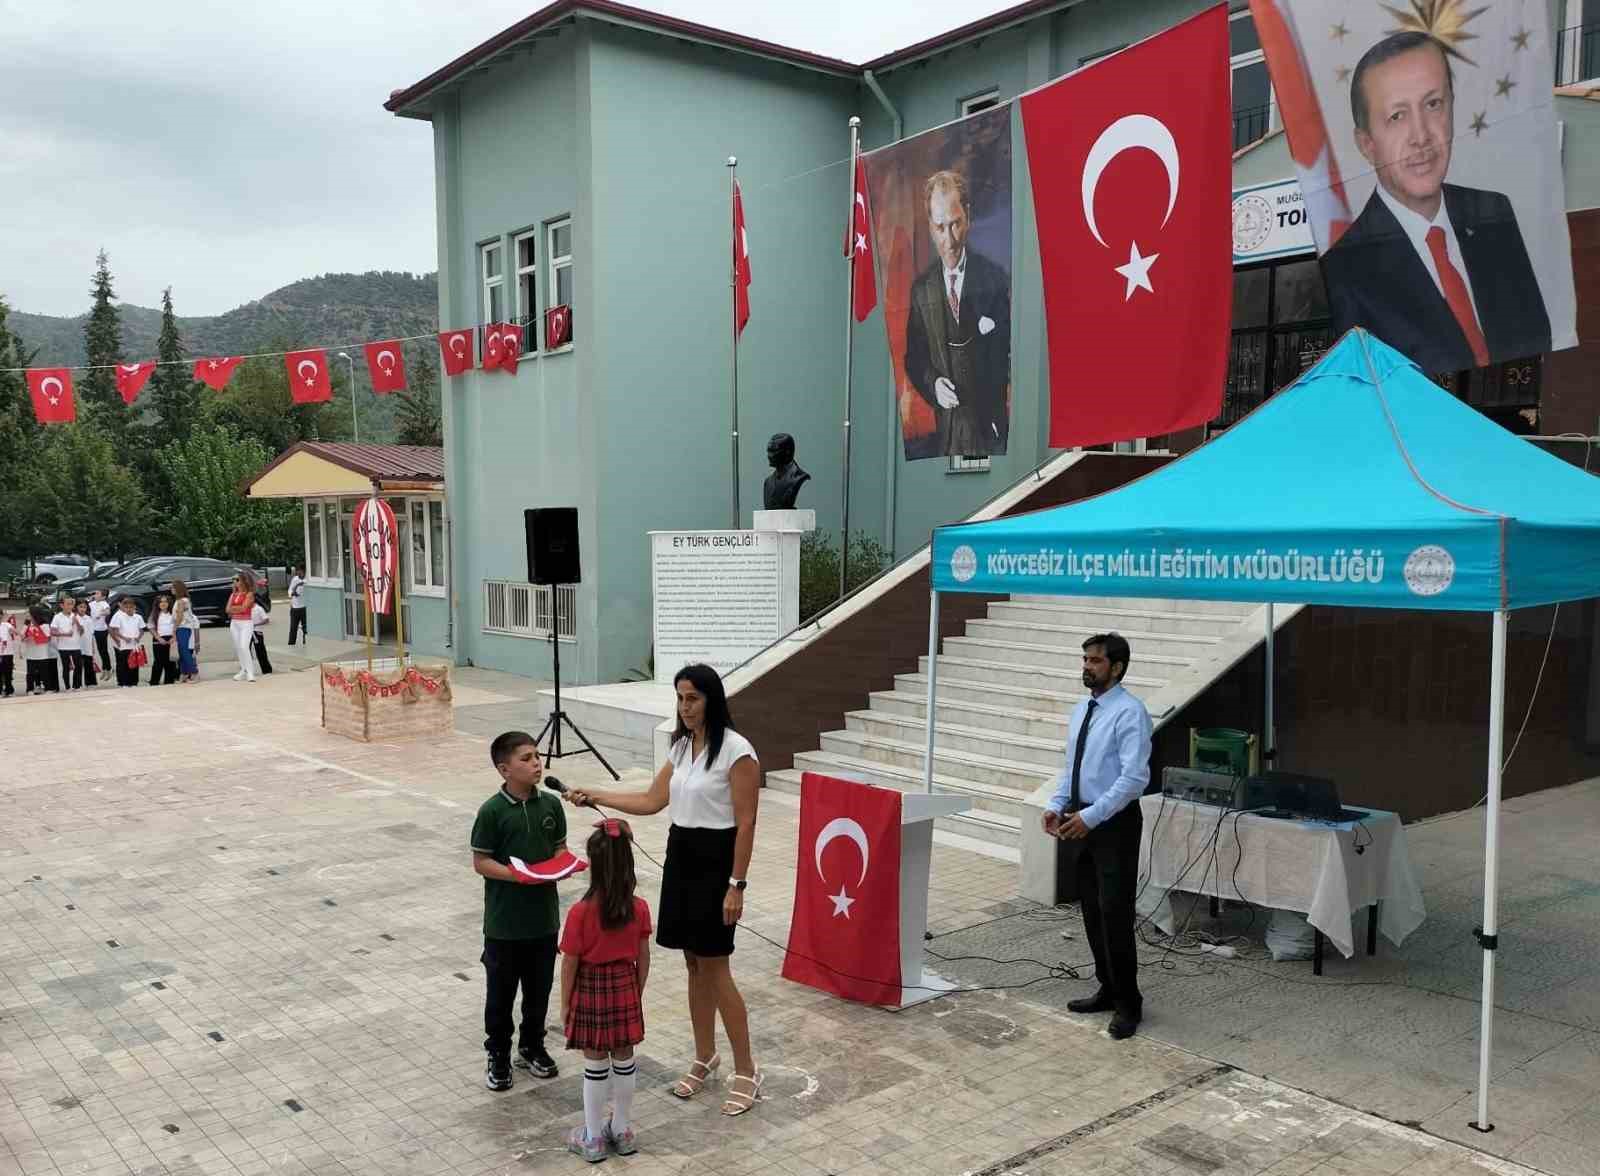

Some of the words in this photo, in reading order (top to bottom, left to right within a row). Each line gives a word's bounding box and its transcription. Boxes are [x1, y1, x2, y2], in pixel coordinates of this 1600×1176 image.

[673, 536, 685, 547] EY
[987, 547, 1065, 576] KÖYCEĞİZ
[1067, 547, 1105, 582] İLÇE
[1107, 547, 1157, 578] MİLLİ
[1159, 547, 1229, 580] EĞİTİM
[1233, 548, 1385, 583] MÜDÜRLÜĞÜ
